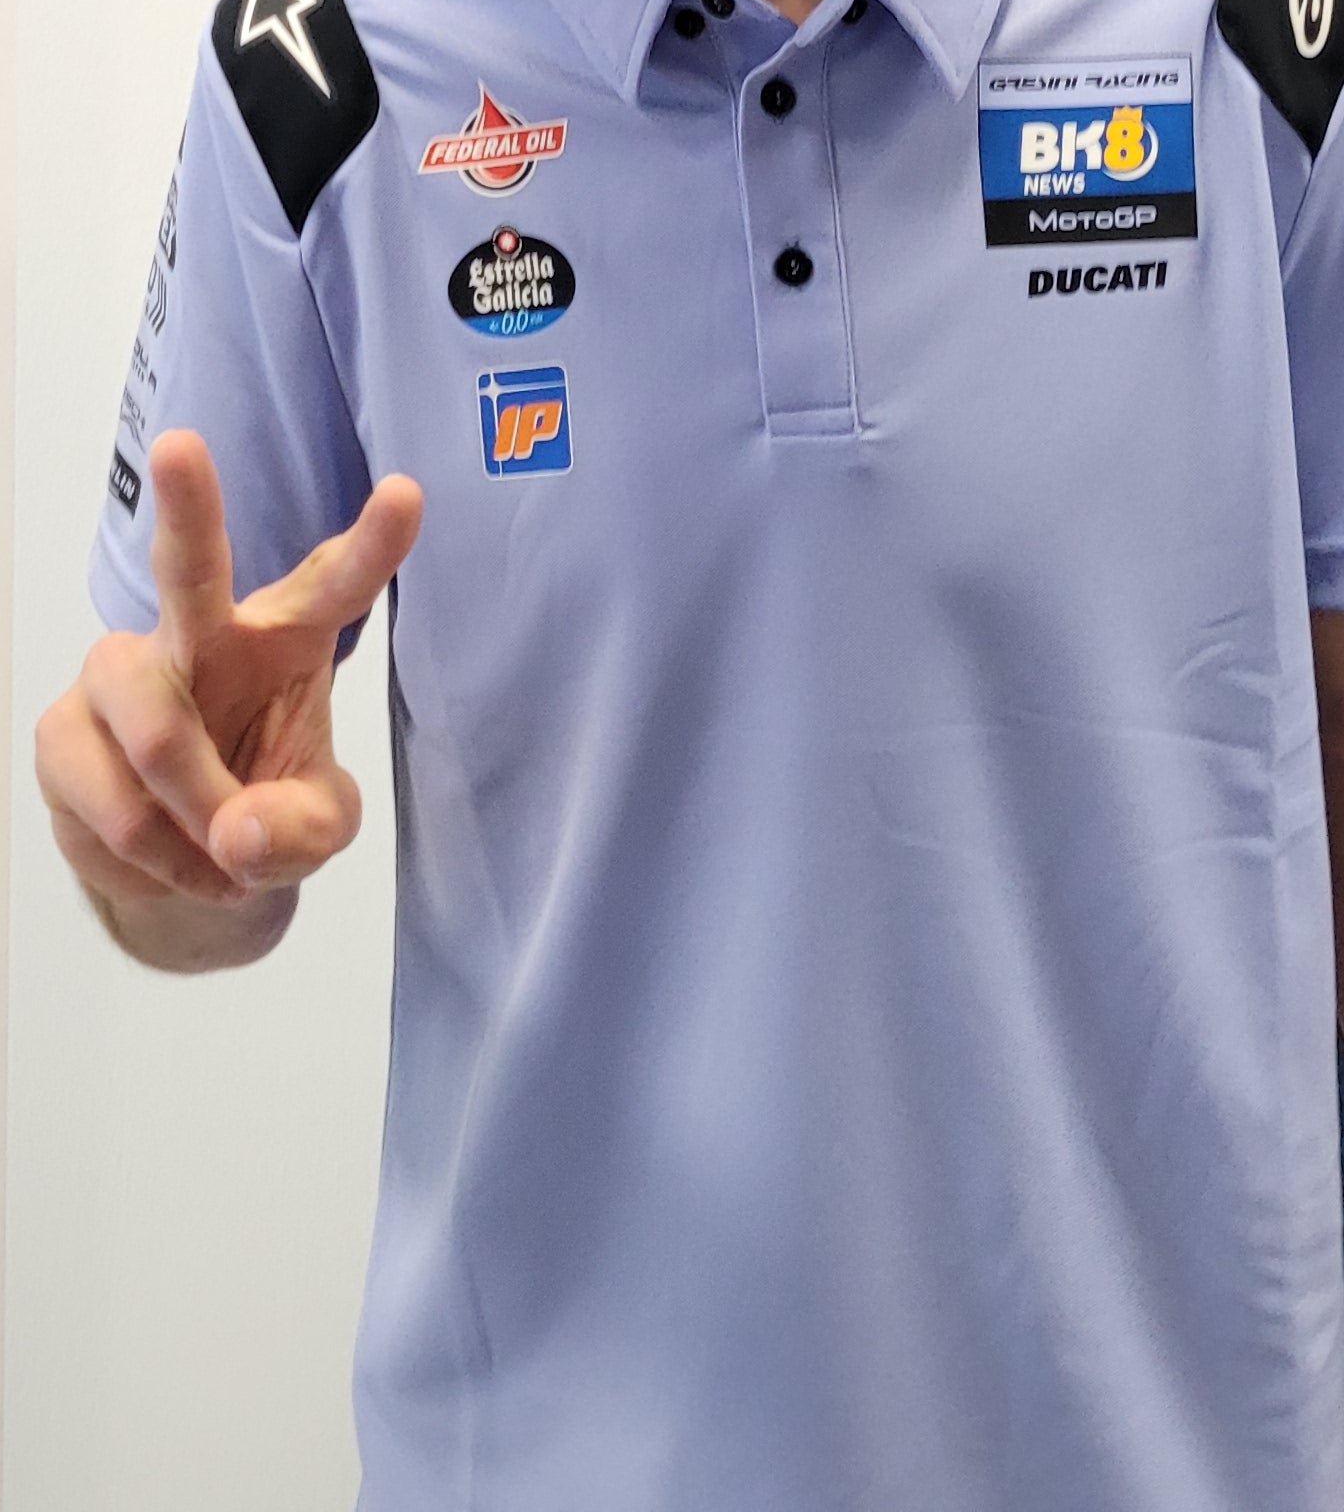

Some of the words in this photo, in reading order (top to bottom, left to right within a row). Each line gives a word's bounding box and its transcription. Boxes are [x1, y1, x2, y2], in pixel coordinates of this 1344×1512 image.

[988, 73, 1078, 92] GRESINI
[1085, 71, 1180, 90] RACING
[431, 131, 522, 165] FEDERAL
[525, 125, 557, 153] OIL
[1019, 119, 1145, 174] BK8
[1023, 172, 1086, 196] NEWS
[469, 251, 554, 288] Estrella
[1027, 260, 1168, 299] DUCATI
[473, 278, 554, 314] Galicia
